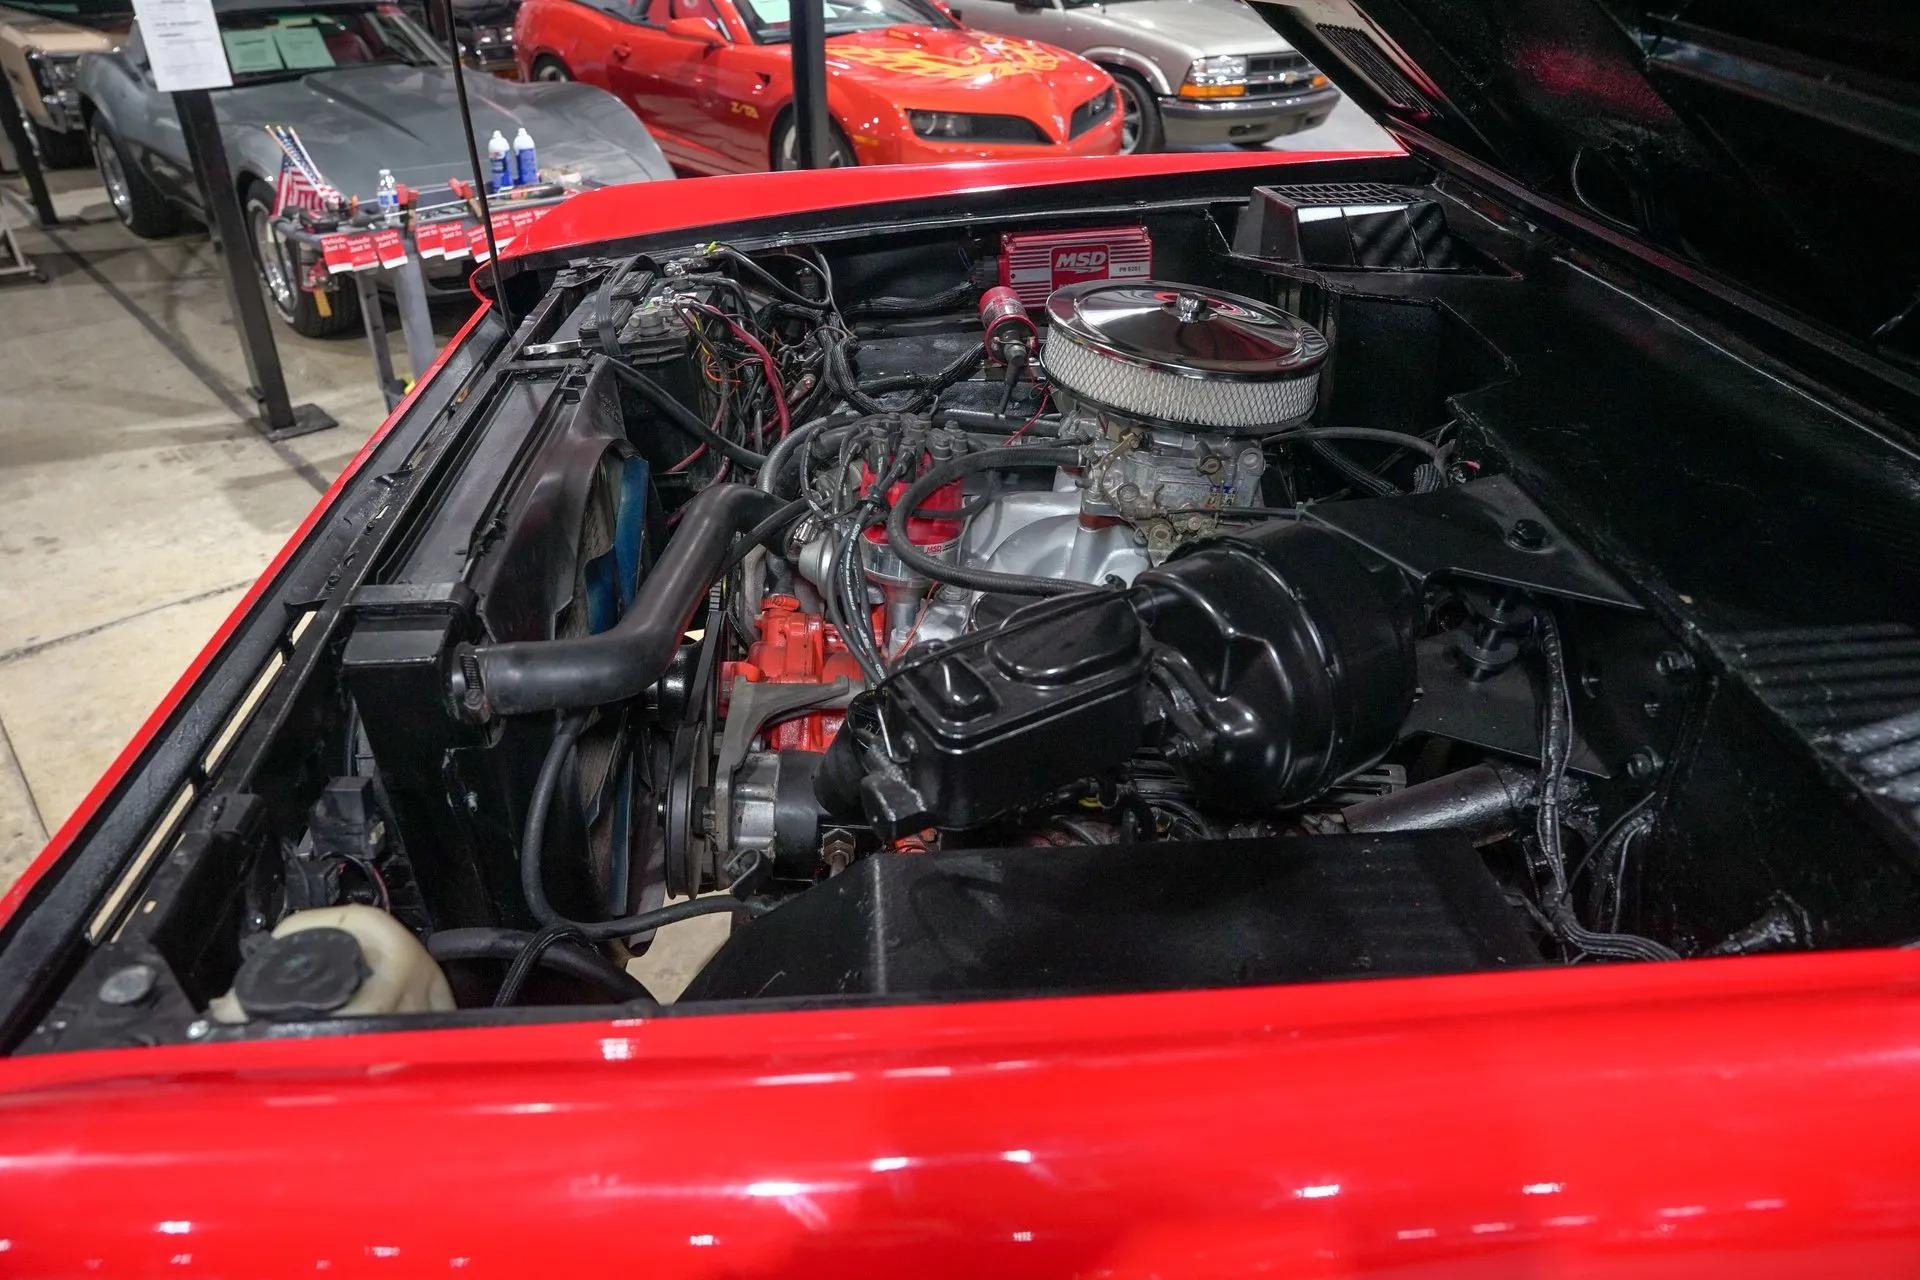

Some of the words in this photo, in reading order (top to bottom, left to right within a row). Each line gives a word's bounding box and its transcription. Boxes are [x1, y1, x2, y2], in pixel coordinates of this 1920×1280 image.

[1055, 251, 1108, 268] MSD
[850, 523, 861, 541] MSD
[927, 544, 942, 553] MSD
[875, 663, 886, 680] MSD
